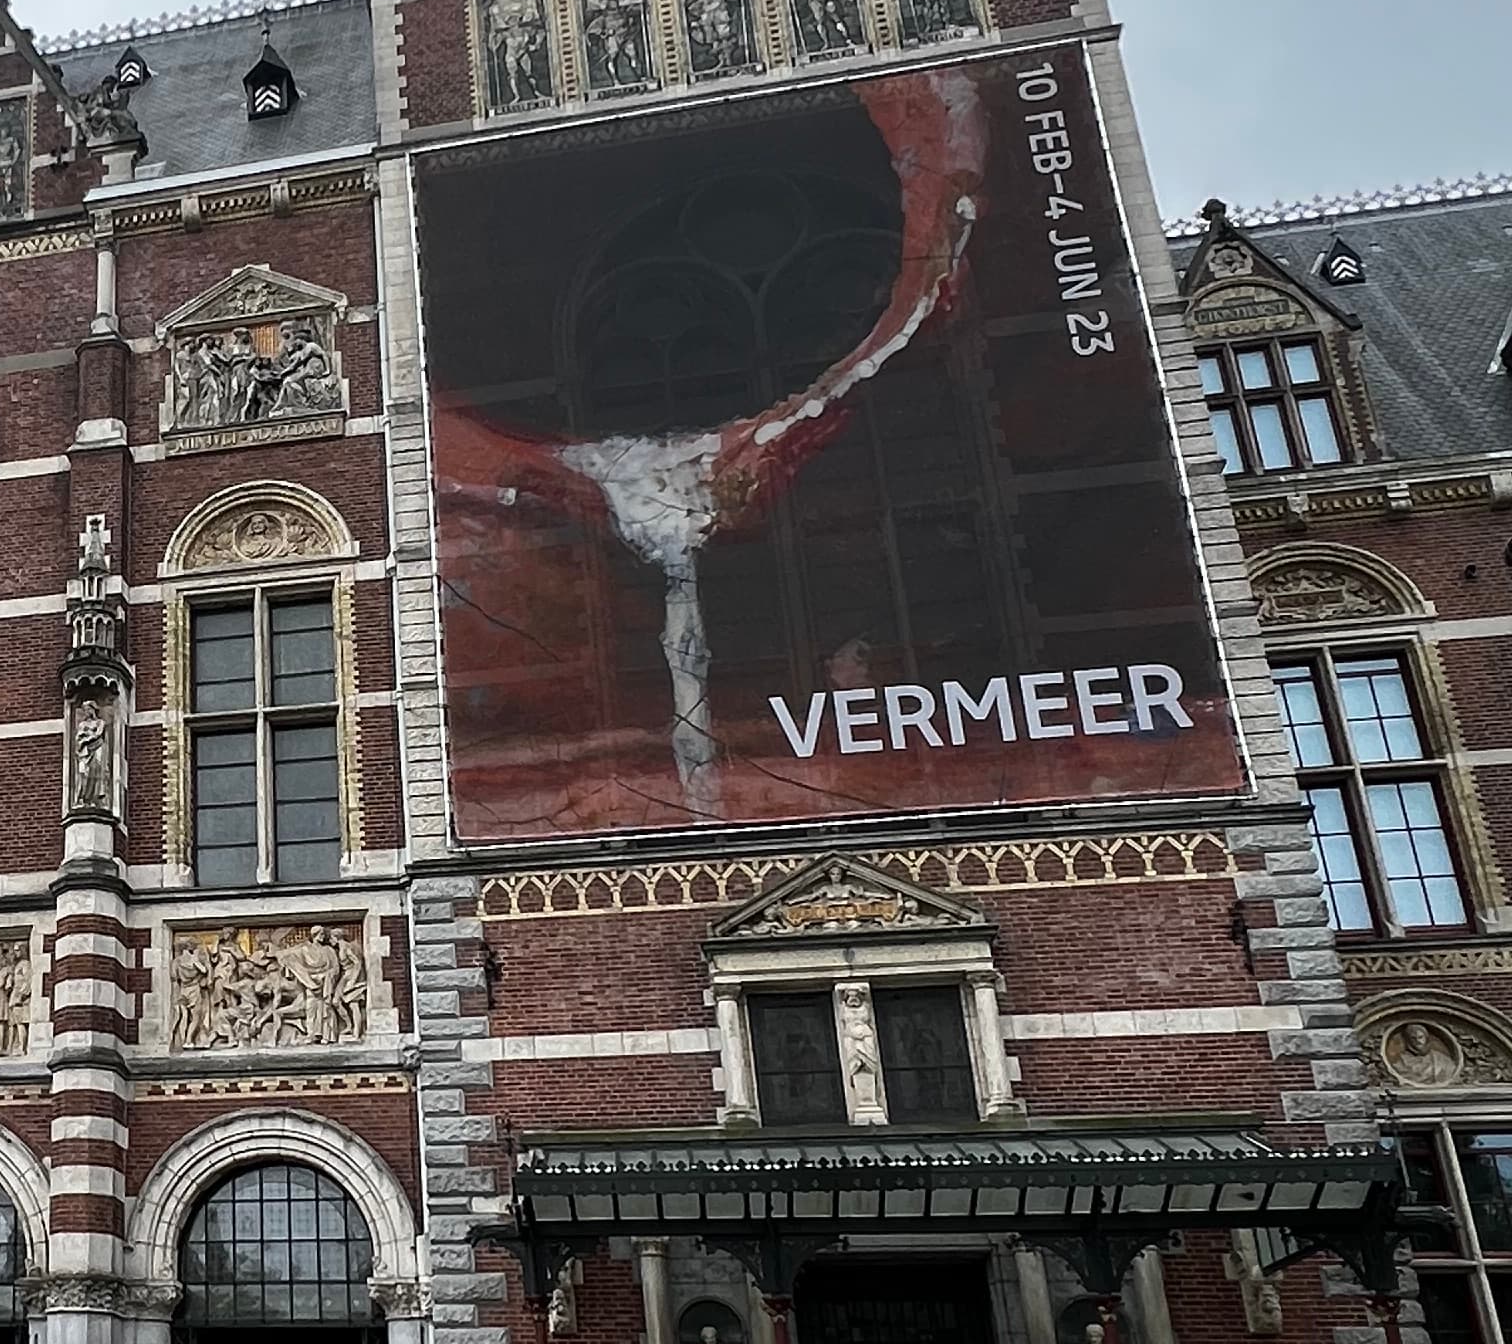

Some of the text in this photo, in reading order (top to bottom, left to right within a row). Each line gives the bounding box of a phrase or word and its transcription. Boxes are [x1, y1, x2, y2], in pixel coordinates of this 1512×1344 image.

[1015, 61, 1059, 102] 10
[1048, 229, 1103, 301] JUN
[1065, 310, 1116, 357] 23
[767, 663, 1195, 758] VERMEER
